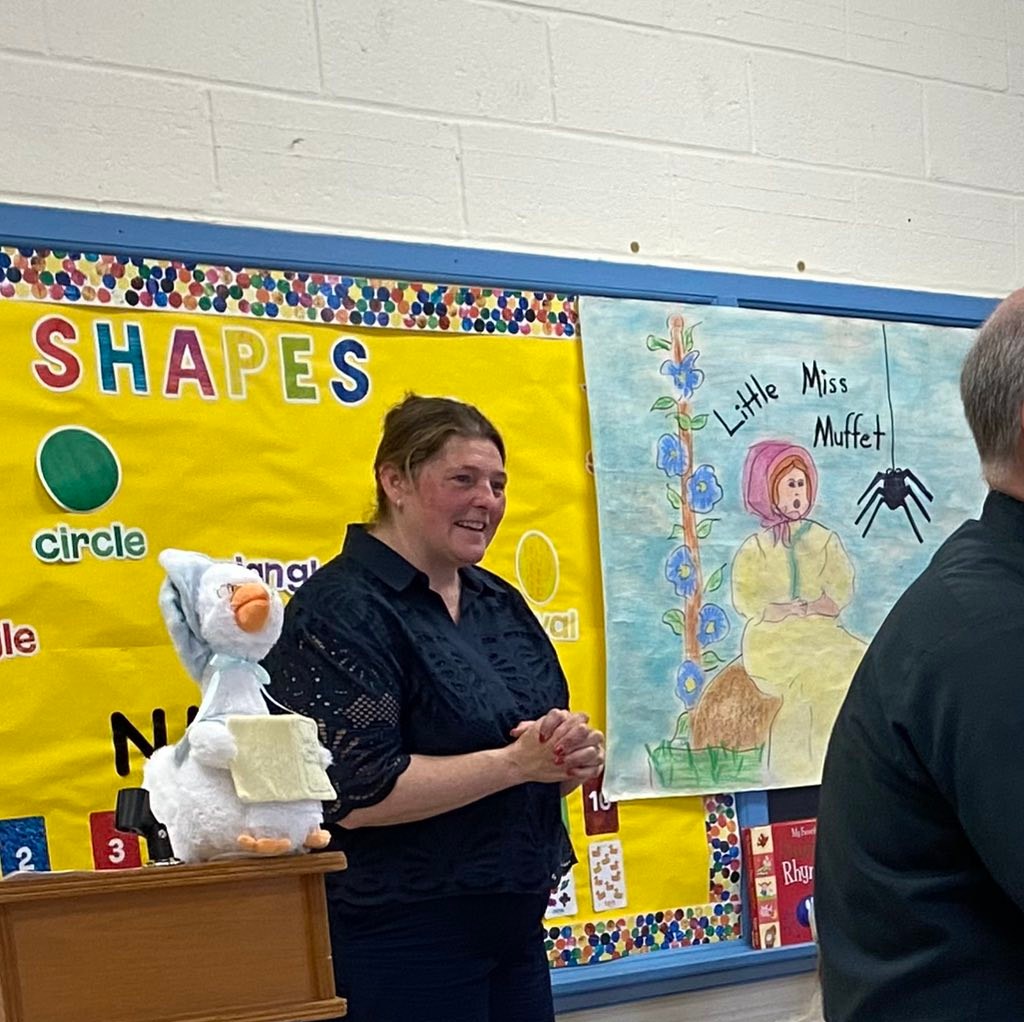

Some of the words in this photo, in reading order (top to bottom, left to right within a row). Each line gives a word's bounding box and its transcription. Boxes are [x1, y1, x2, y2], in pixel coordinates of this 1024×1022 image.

[33, 317, 370, 404] SHAPES
[712, 374, 779, 437] Little
[801, 360, 848, 398] Miss
[813, 412, 886, 450] Muffet
[34, 525, 146, 560] circle
[0, 623, 37, 657] le
[15, 846, 35, 871] 2
[108, 838, 125, 863] 3
